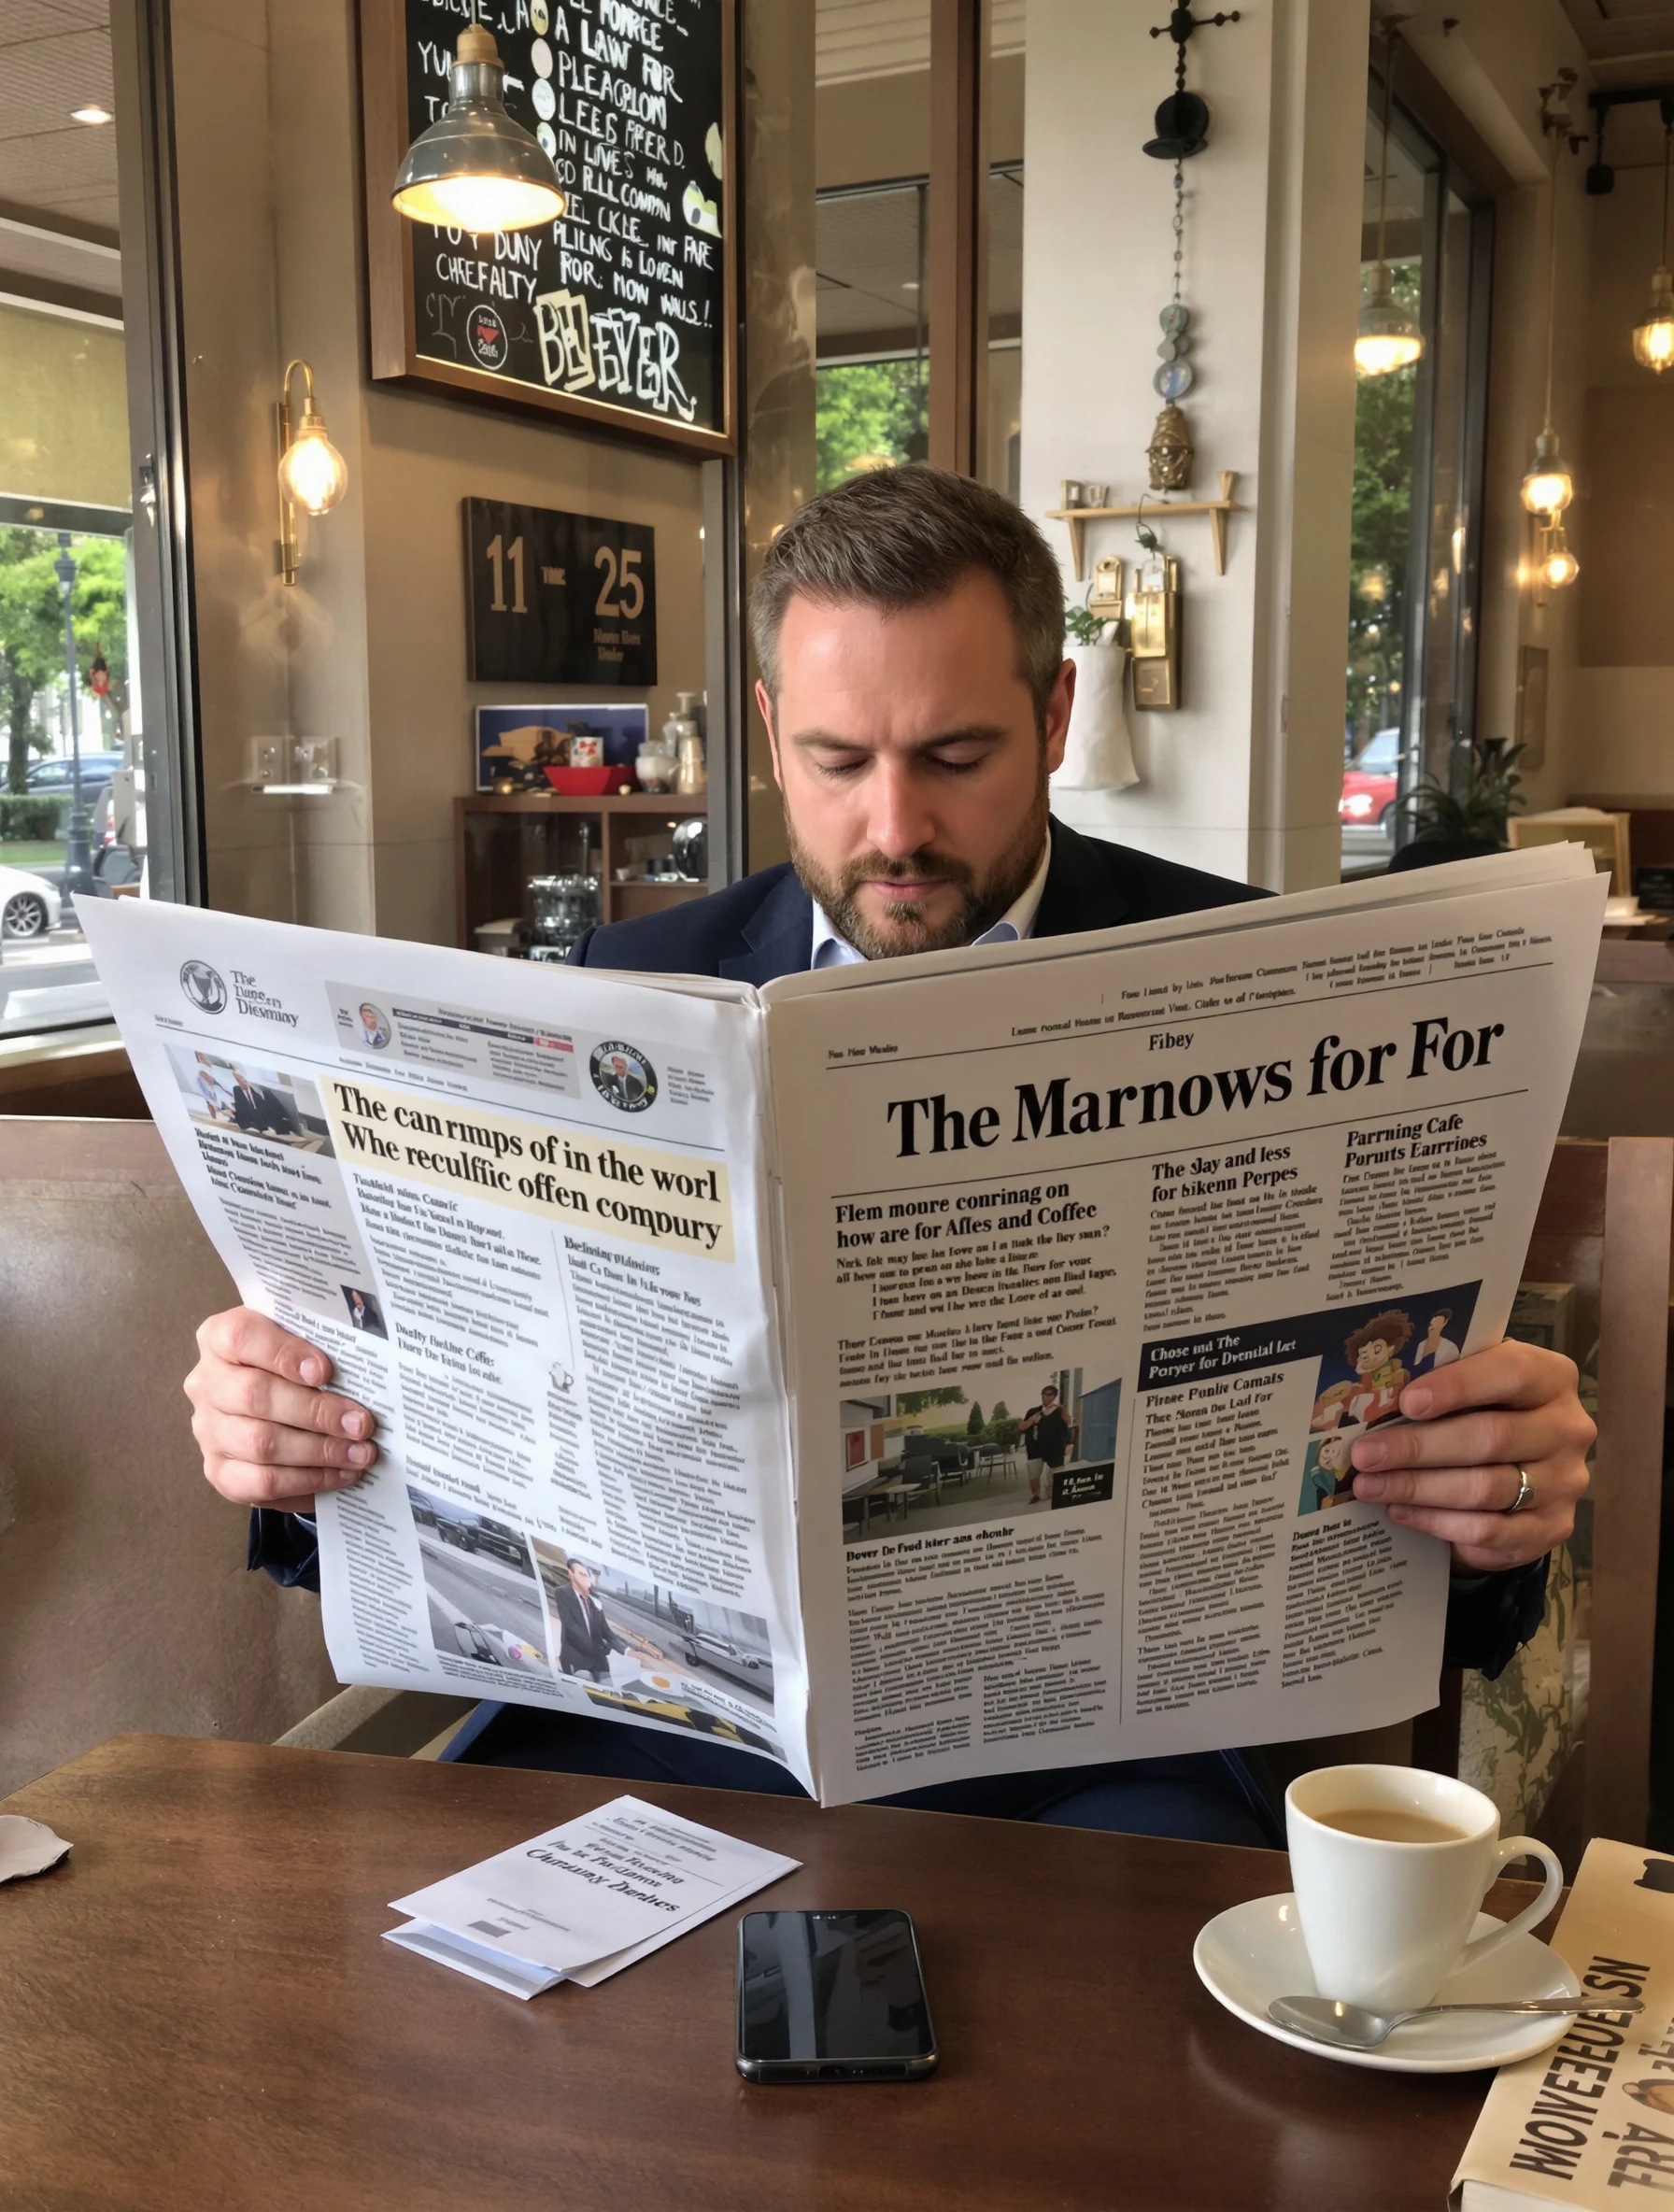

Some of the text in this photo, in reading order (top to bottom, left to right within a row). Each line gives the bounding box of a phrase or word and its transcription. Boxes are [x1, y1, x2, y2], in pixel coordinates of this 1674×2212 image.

[554, 6, 570, 44] A
[581, 19, 632, 70] LAW
[642, 52, 684, 104] FOR
[487, 534, 527, 613] 11
[594, 546, 645, 619] 25
[230, 970, 257, 987] The
[887, 1016, 1505, 1158] The Marnows for For
[334, 1082, 388, 1122] The
[530, 1135, 558, 1163] of
[564, 1141, 592, 1173] in
[597, 1149, 645, 1186] the
[651, 1166, 720, 1203] worl
[340, 1120, 401, 1162] Whe
[518, 1171, 589, 1213] offen
[1152, 1162, 1185, 1181] The
[1225, 1147, 1256, 1168] and
[1260, 1146, 1291, 1162] less
[834, 1204, 883, 1224] Flem
[1046, 1183, 1070, 1200] on
[1152, 1185, 1177, 1202] for
[836, 1229, 875, 1249] how
[880, 1227, 910, 1244] are
[915, 1222, 943, 1241] for
[998, 1210, 1033, 1229] and
[1216, 1335, 1241, 1351] The
[1199, 1356, 1219, 1371] for
